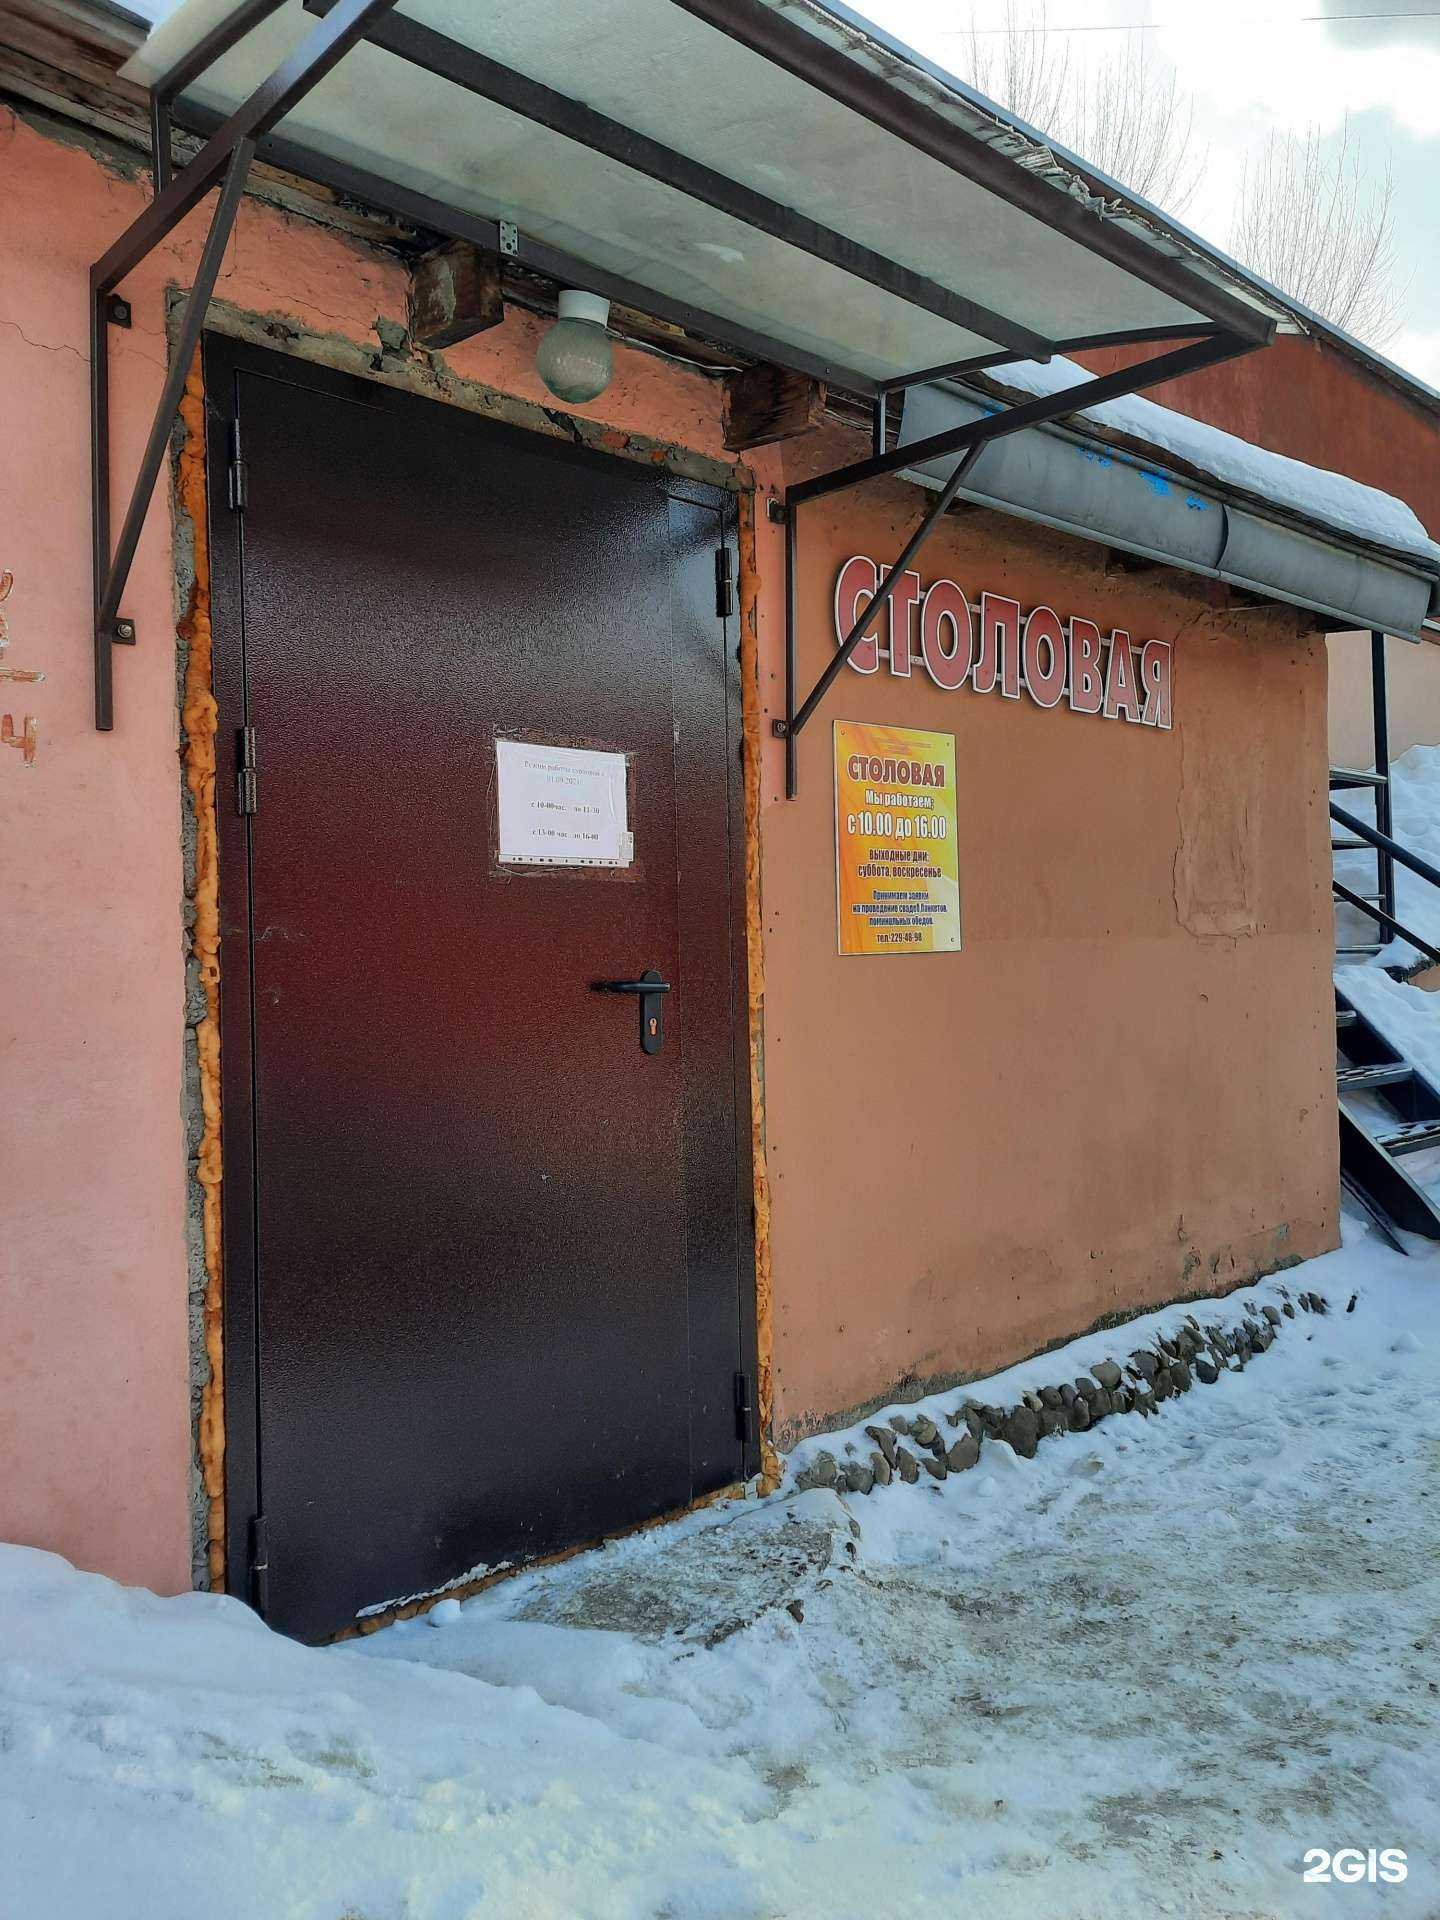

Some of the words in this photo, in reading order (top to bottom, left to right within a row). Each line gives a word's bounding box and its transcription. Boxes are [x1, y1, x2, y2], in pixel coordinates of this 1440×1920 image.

[834, 555, 1173, 730] СТОЛОВАЯ
[848, 754, 946, 788] СТОЛОВАЯ
[865, 789, 883, 805] Мы
[858, 811, 893, 836] 10.00
[895, 817, 912, 840] до
[914, 815, 947, 839] 16.00
[869, 849, 911, 863] выходные
[858, 863, 892, 878] суббота,
[892, 865, 942, 878] воскресенье
